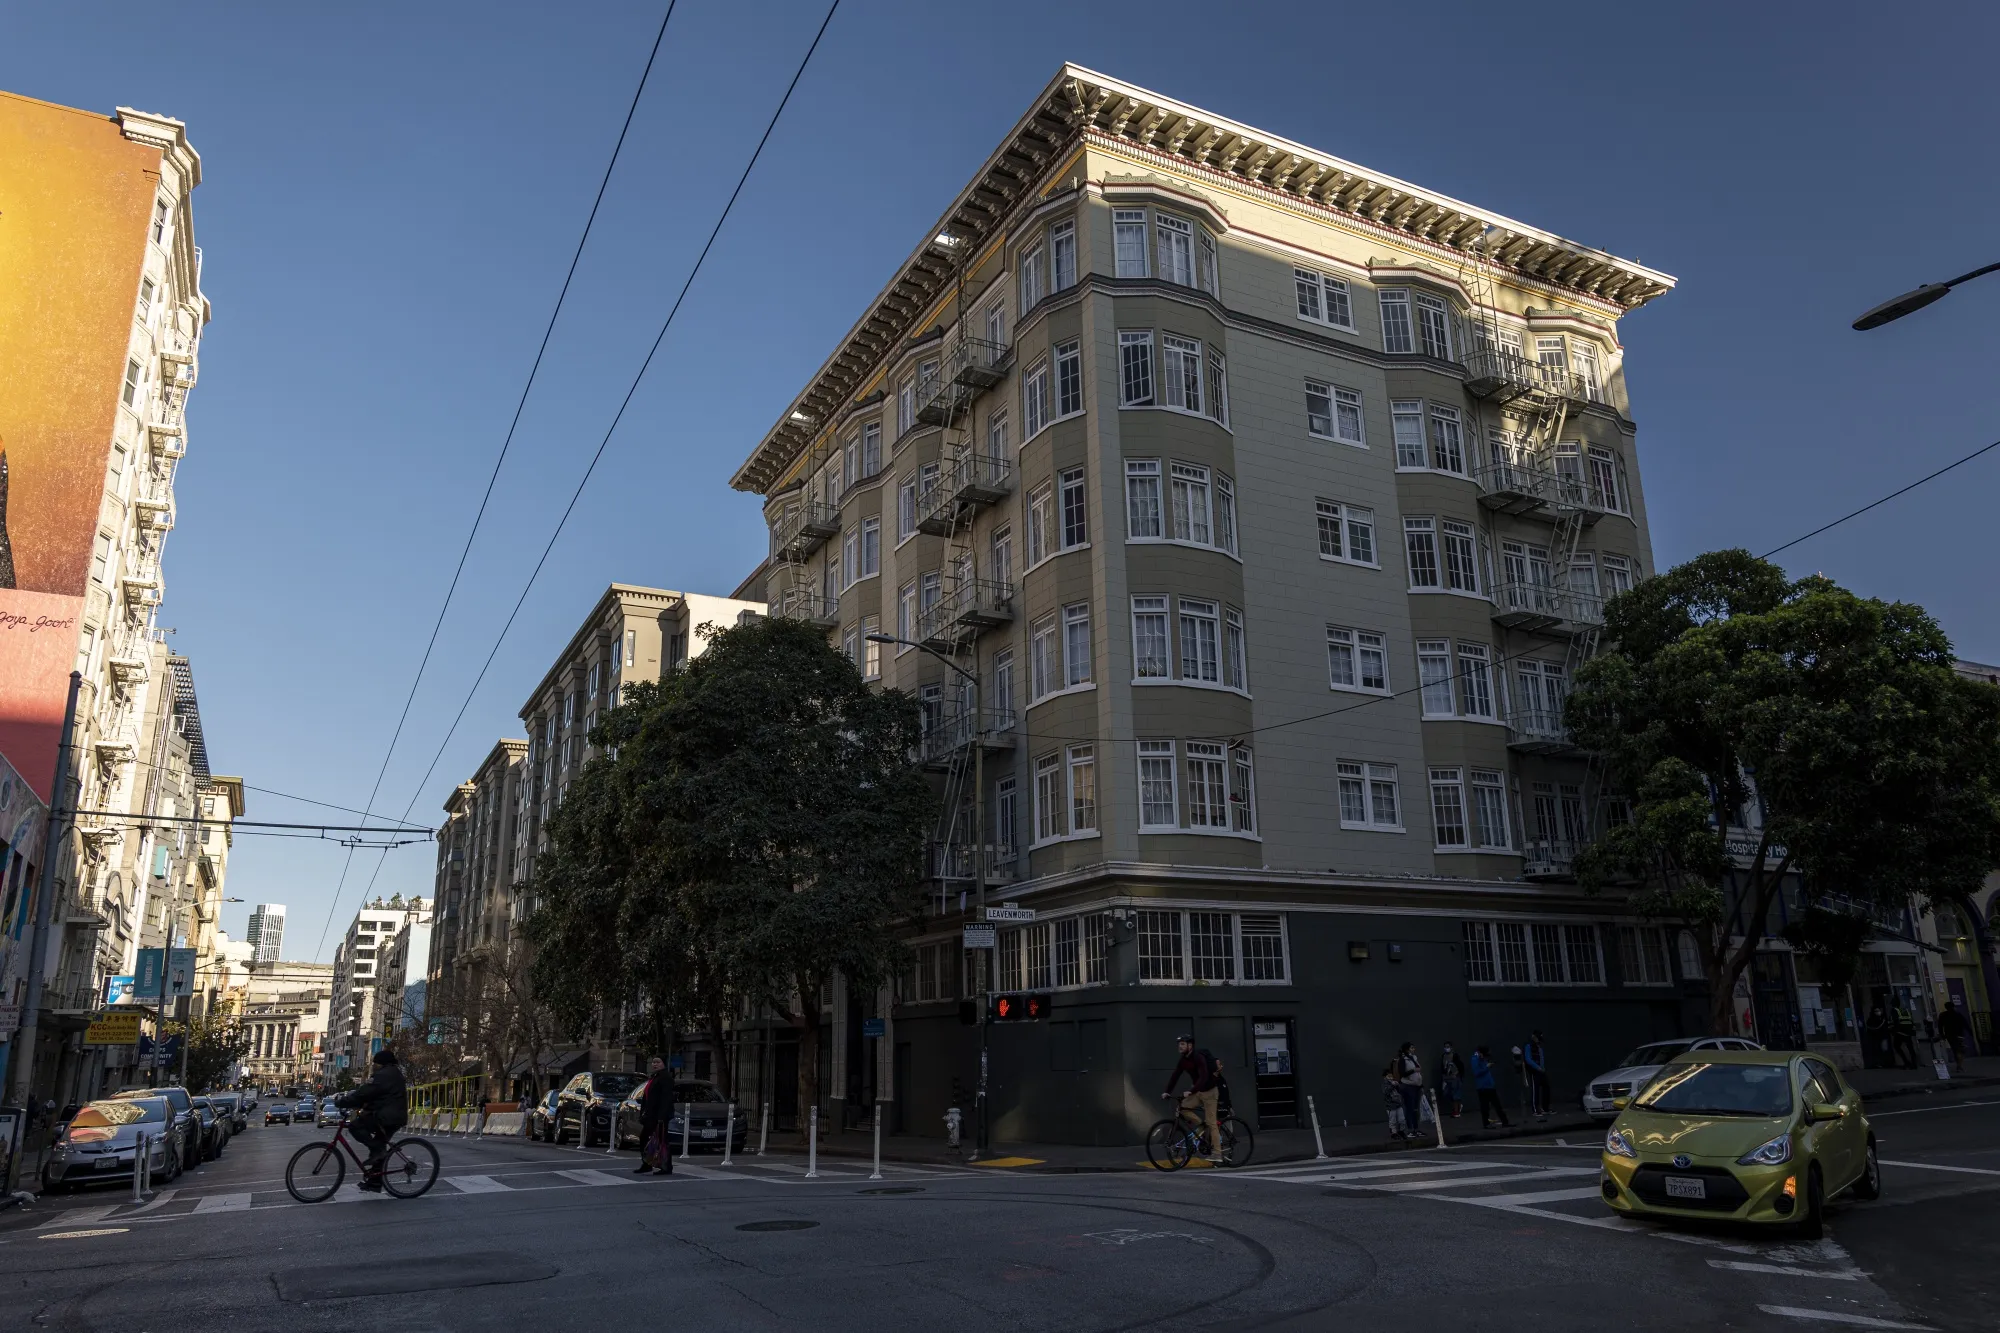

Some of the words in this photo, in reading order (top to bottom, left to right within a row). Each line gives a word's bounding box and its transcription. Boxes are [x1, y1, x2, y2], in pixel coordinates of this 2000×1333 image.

[988, 909, 1034, 919] LEAVENWORTH
[90, 1023, 107, 1031] KCC
[1668, 1183, 1703, 1196] 7PSX891
